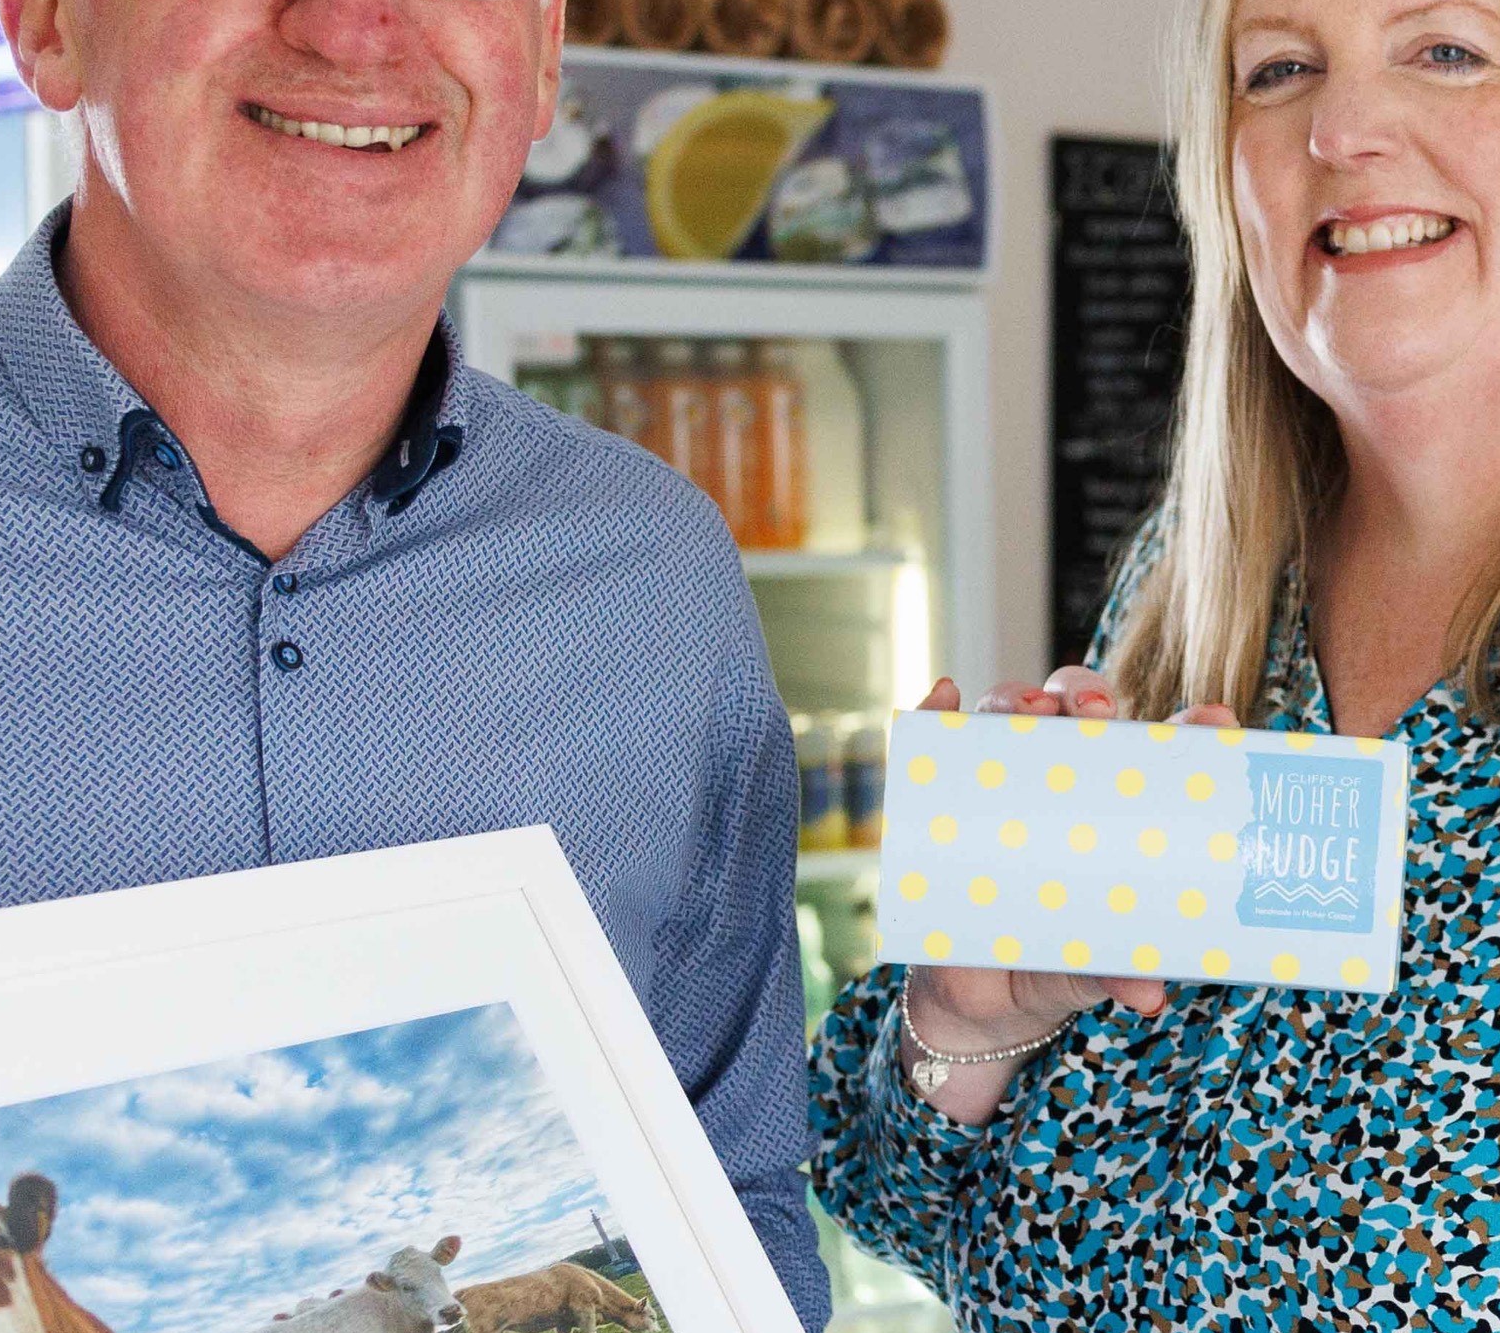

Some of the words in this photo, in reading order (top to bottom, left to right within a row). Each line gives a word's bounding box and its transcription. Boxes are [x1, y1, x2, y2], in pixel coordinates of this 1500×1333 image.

[1259, 771, 1360, 830] MOHER
[1287, 772, 1335, 786] CLIFFS
[1341, 776, 1362, 788] OF
[1256, 824, 1360, 884] FUDGE
